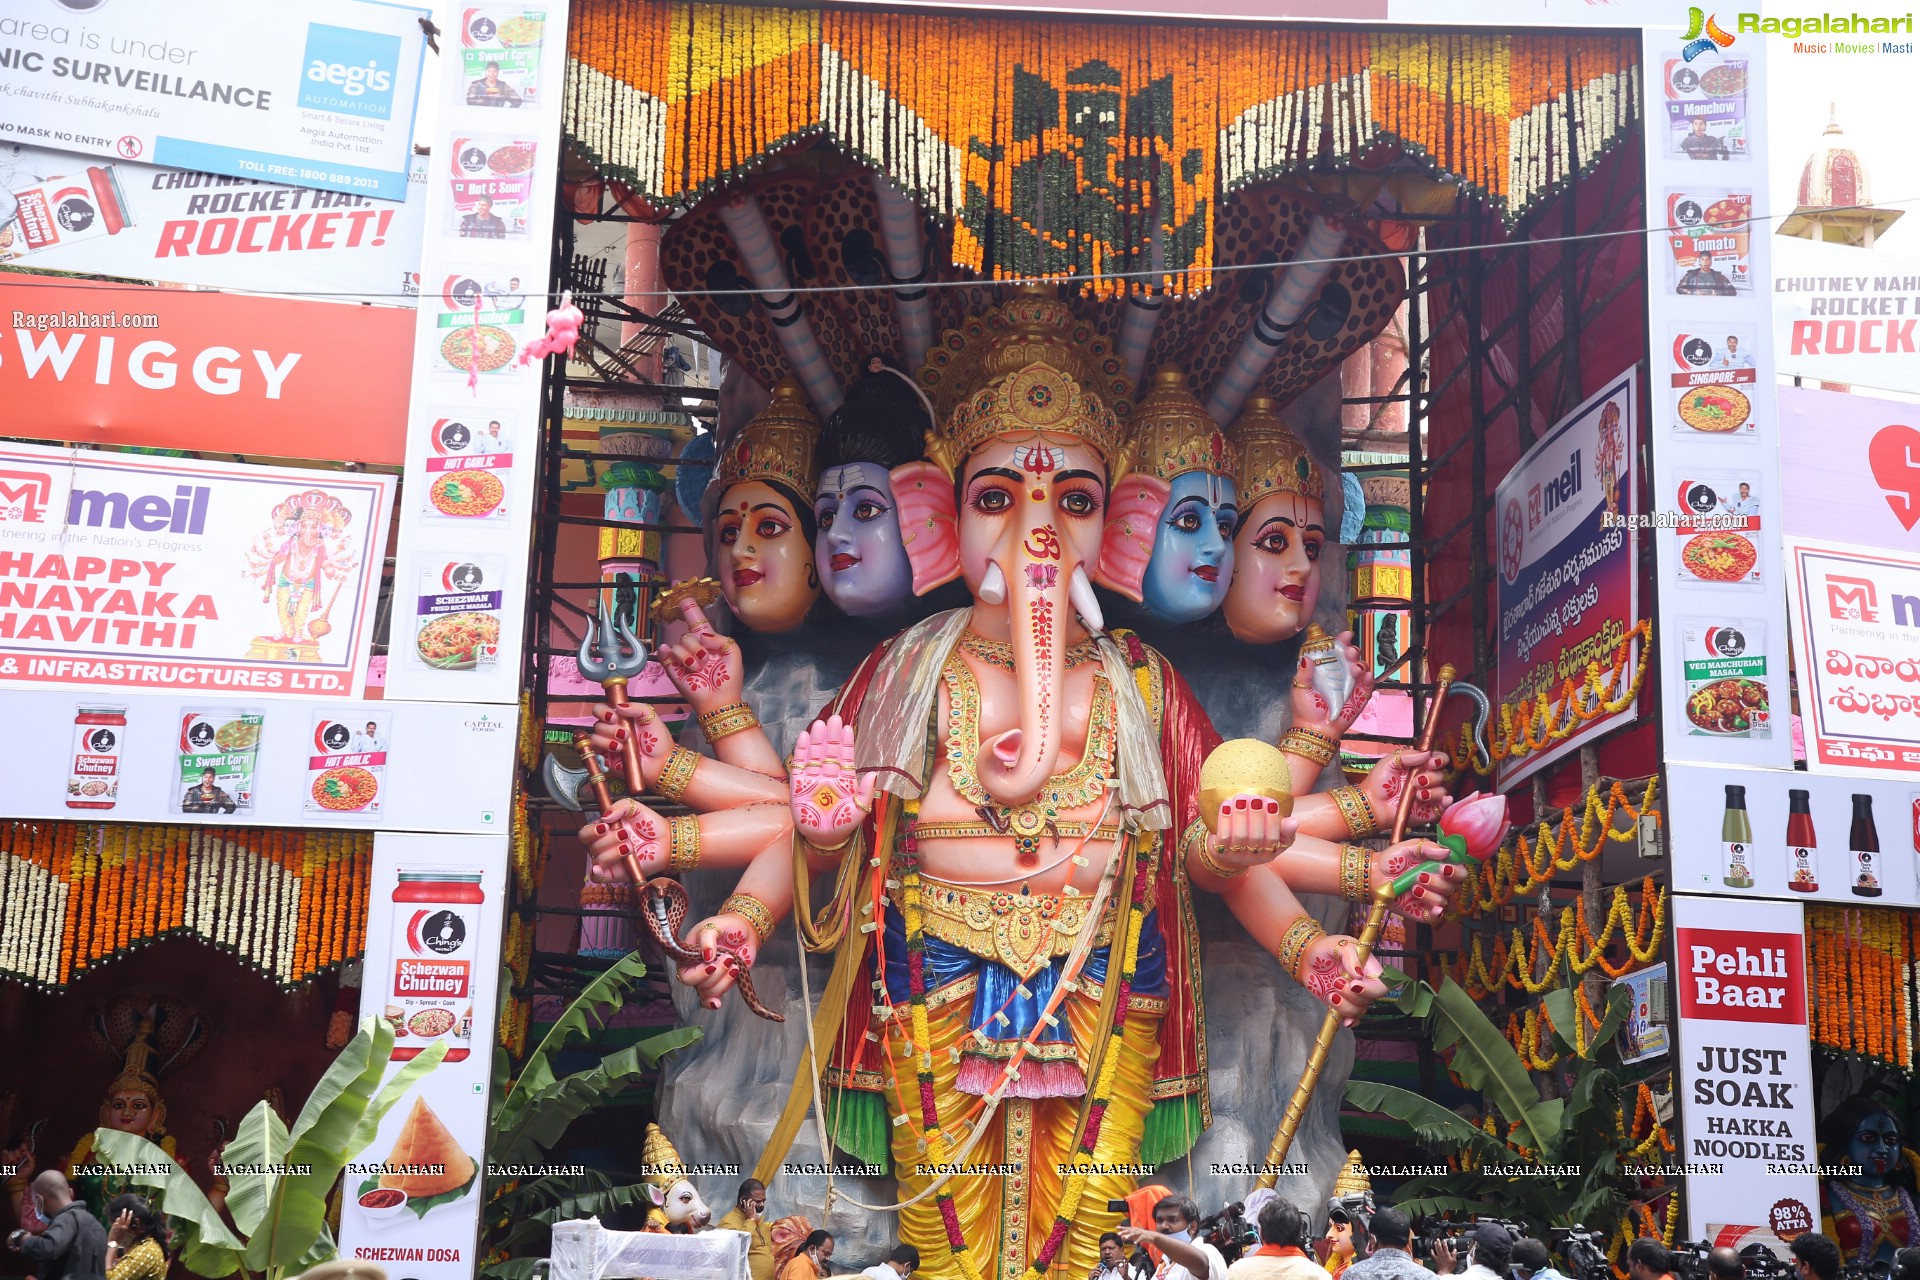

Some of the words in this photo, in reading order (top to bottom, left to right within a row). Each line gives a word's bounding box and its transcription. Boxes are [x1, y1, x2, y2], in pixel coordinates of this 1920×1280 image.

[0, 18, 69, 44] area
[80, 26, 100, 49] is
[110, 36, 198, 66] under
[52, 56, 272, 111] SURVEILLANCE
[307, 60, 391, 96] aegis
[14, 85, 64, 103] chavithi
[64, 94, 161, 119] Subhakankshalu
[305, 94, 386, 114] AUTOMATION
[1684, 102, 1735, 116] Manchow
[301, 111, 325, 122] Smart
[335, 117, 361, 127] Secure
[363, 119, 385, 132] Living
[17, 125, 51, 139] MASK
[54, 130, 72, 141] NO
[75, 134, 112, 148] ENTRY
[300, 126, 326, 138] Aegis
[328, 130, 383, 146] Automation
[311, 138, 334, 149] India
[337, 142, 353, 151] Pvt.
[355, 144, 371, 154] Ltd.
[238, 160, 266, 173] TOLL
[268, 164, 298, 177] FREE:
[300, 168, 327, 181] 1800
[329, 173, 351, 185] 889
[353, 177, 378, 189] 2013
[468, 184, 487, 195] Hot
[489, 183, 497, 193] &
[499, 182, 524, 193] Sour
[187, 188, 308, 215] ROCKET
[18, 195, 43, 244] Chutney
[30, 192, 54, 242] Schezwan
[154, 209, 395, 258] ROCKET!
[1692, 237, 1736, 252] Tomato
[403, 272, 412, 284] I
[1775, 277, 1868, 292] CHUTNEY
[1810, 297, 1908, 315] ROCKET
[450, 312, 512, 326] MANHURIAN
[0, 328, 303, 400] WIGGY
[1689, 371, 1735, 385] SINGAPORE
[444, 458, 464, 470] HOT
[464, 456, 496, 469] GARLIC
[1544, 448, 1582, 517] meil
[66, 485, 211, 535] meil
[51, 532, 62, 541] in
[68, 533, 88, 544] the
[93, 534, 142, 548] Nation's
[148, 539, 202, 552] Progress
[0, 550, 176, 587] HAPPY
[435, 594, 489, 605] SCHEZWAN
[466, 602, 492, 610] MASALA
[1831, 624, 1885, 640] Partnering
[1889, 632, 1898, 640] in
[1903, 633, 1919, 642] the
[0, 657, 19, 675] &
[28, 658, 283, 689] INFRASTRUCTURES
[291, 671, 345, 691] LTD.
[1689, 662, 1706, 670] VEG
[1708, 659, 1763, 669] MANCHURIAN
[1709, 669, 1743, 677] MASALA
[464, 720, 504, 729] CAPITAL
[77, 763, 113, 774] Chutney
[78, 756, 114, 765] Schezwan
[196, 756, 225, 768] Sweet
[228, 755, 250, 766] Corn
[325, 756, 343, 767] HOT
[343, 754, 371, 766] GARLIC
[426, 937, 463, 948] Ching's
[401, 962, 464, 976] Schezwan
[1691, 945, 1787, 978] Pehli
[400, 975, 463, 995] Chutney
[1696, 977, 1786, 1009] Baar
[1697, 1046, 1787, 1076] JUST
[1707, 1117, 1793, 1138] HAKKA
[1694, 1139, 1805, 1162] NOODLES
[1773, 1205, 1805, 1221] 98%
[1777, 1219, 1808, 1230] ATTA
[355, 1247, 424, 1262] SCHEZWAN
[427, 1249, 460, 1262] DOSA
